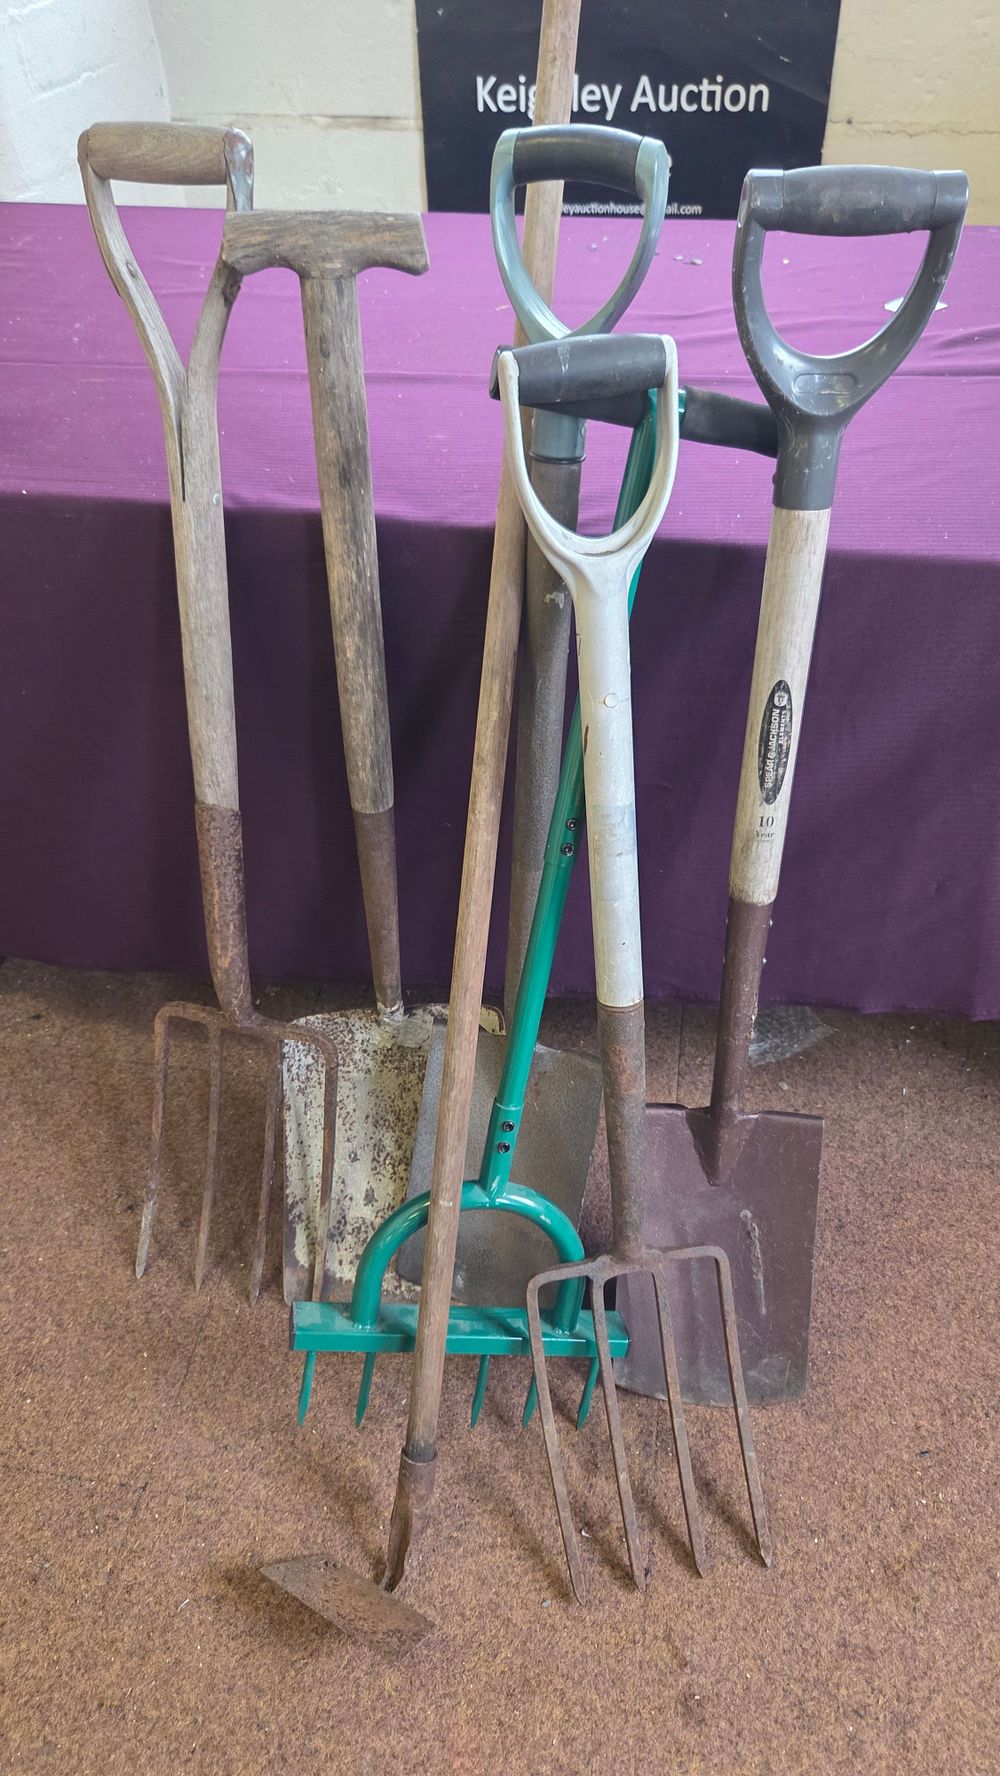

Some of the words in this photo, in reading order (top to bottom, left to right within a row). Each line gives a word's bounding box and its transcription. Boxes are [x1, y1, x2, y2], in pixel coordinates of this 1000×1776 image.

[476, 73, 622, 121] Keigley
[630, 74, 769, 113] Auction
[768, 708, 780, 751] JACKSON
[764, 760, 775, 789] SPEAR
[759, 815, 775, 828] 10
